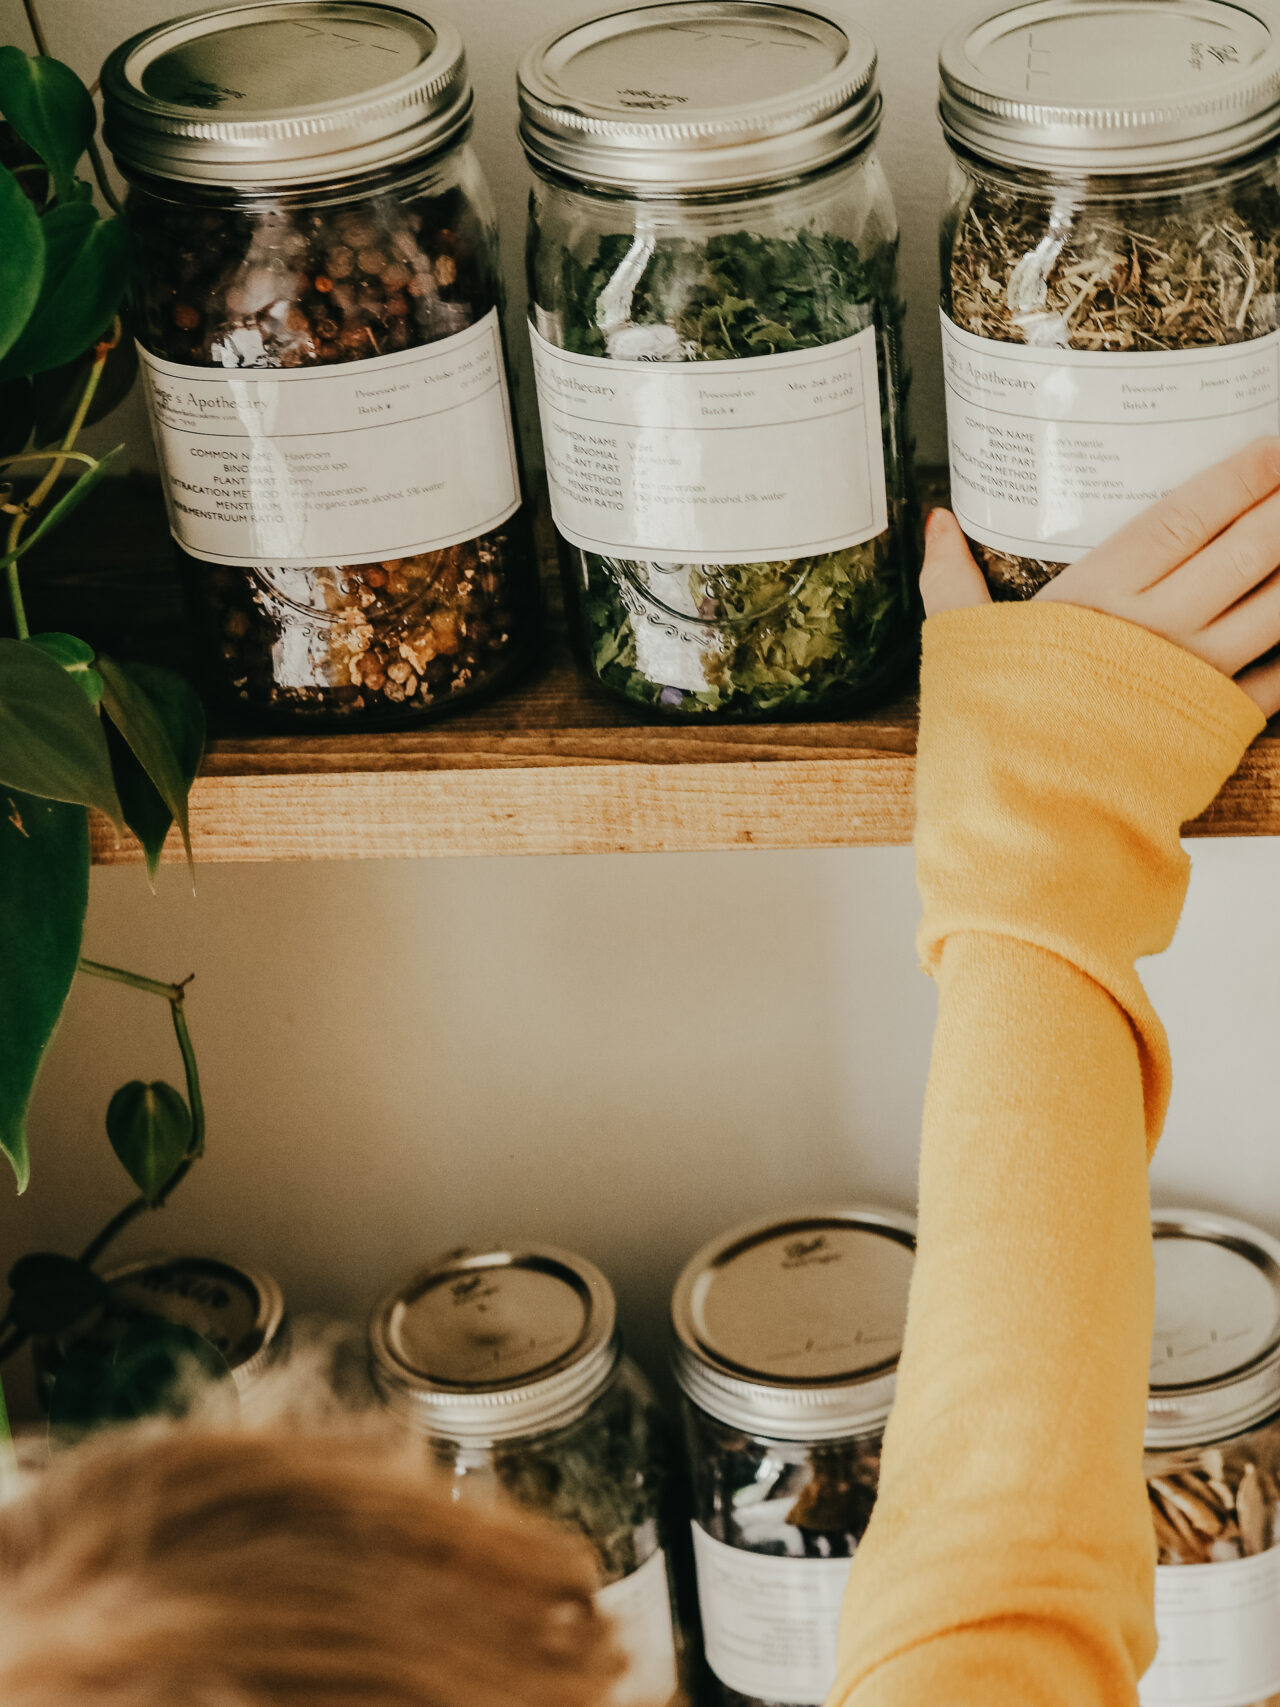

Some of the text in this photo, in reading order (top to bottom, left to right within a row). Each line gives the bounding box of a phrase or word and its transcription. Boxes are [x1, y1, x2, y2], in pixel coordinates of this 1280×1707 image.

[967, 360, 1038, 396] Apothecary
[355, 384, 398, 399] Processed
[699, 389, 742, 400] Processed
[1121, 383, 1164, 394] Processed
[188, 392, 269, 415] Apothecary
[358, 404, 384, 415] Batch
[1122, 399, 1148, 411] Batch
[701, 407, 727, 417] Batch
[552, 421, 587, 443] COMMON
[589, 434, 617, 448] NAME
[965, 415, 1003, 438] COMMON
[1006, 429, 1036, 443] NAME
[189, 447, 331, 461] COMMON NAME Hawthorn
[573, 444, 620, 461] BINOMIAL
[989, 439, 1036, 456] BINOMIAL
[566, 453, 593, 469] PLANT
[596, 460, 621, 473] PART
[980, 448, 1008, 464] PLANT
[1012, 455, 1036, 469] PART
[223, 463, 273, 474] BINOMIAL
[995, 463, 1038, 481] METHOD
[1077, 479, 1125, 490] maceration
[213, 476, 247, 486] PLANT
[250, 477, 277, 486] PART
[580, 470, 622, 487] METHOD
[979, 472, 1038, 494] MENSTRUUM
[215, 500, 282, 511] MENSTRUUM
[314, 500, 346, 512] organic
[349, 497, 370, 507] cane
[421, 481, 446, 494] water
[233, 489, 281, 499] METHOD
[318, 486, 368, 498] maceration
[567, 478, 624, 499] MENSTRUUM
[687, 495, 708, 505] cane
[760, 491, 787, 502] water
[1008, 491, 1039, 507] RATIO
[595, 498, 625, 512] RATIO
[250, 514, 285, 524] RATIO
